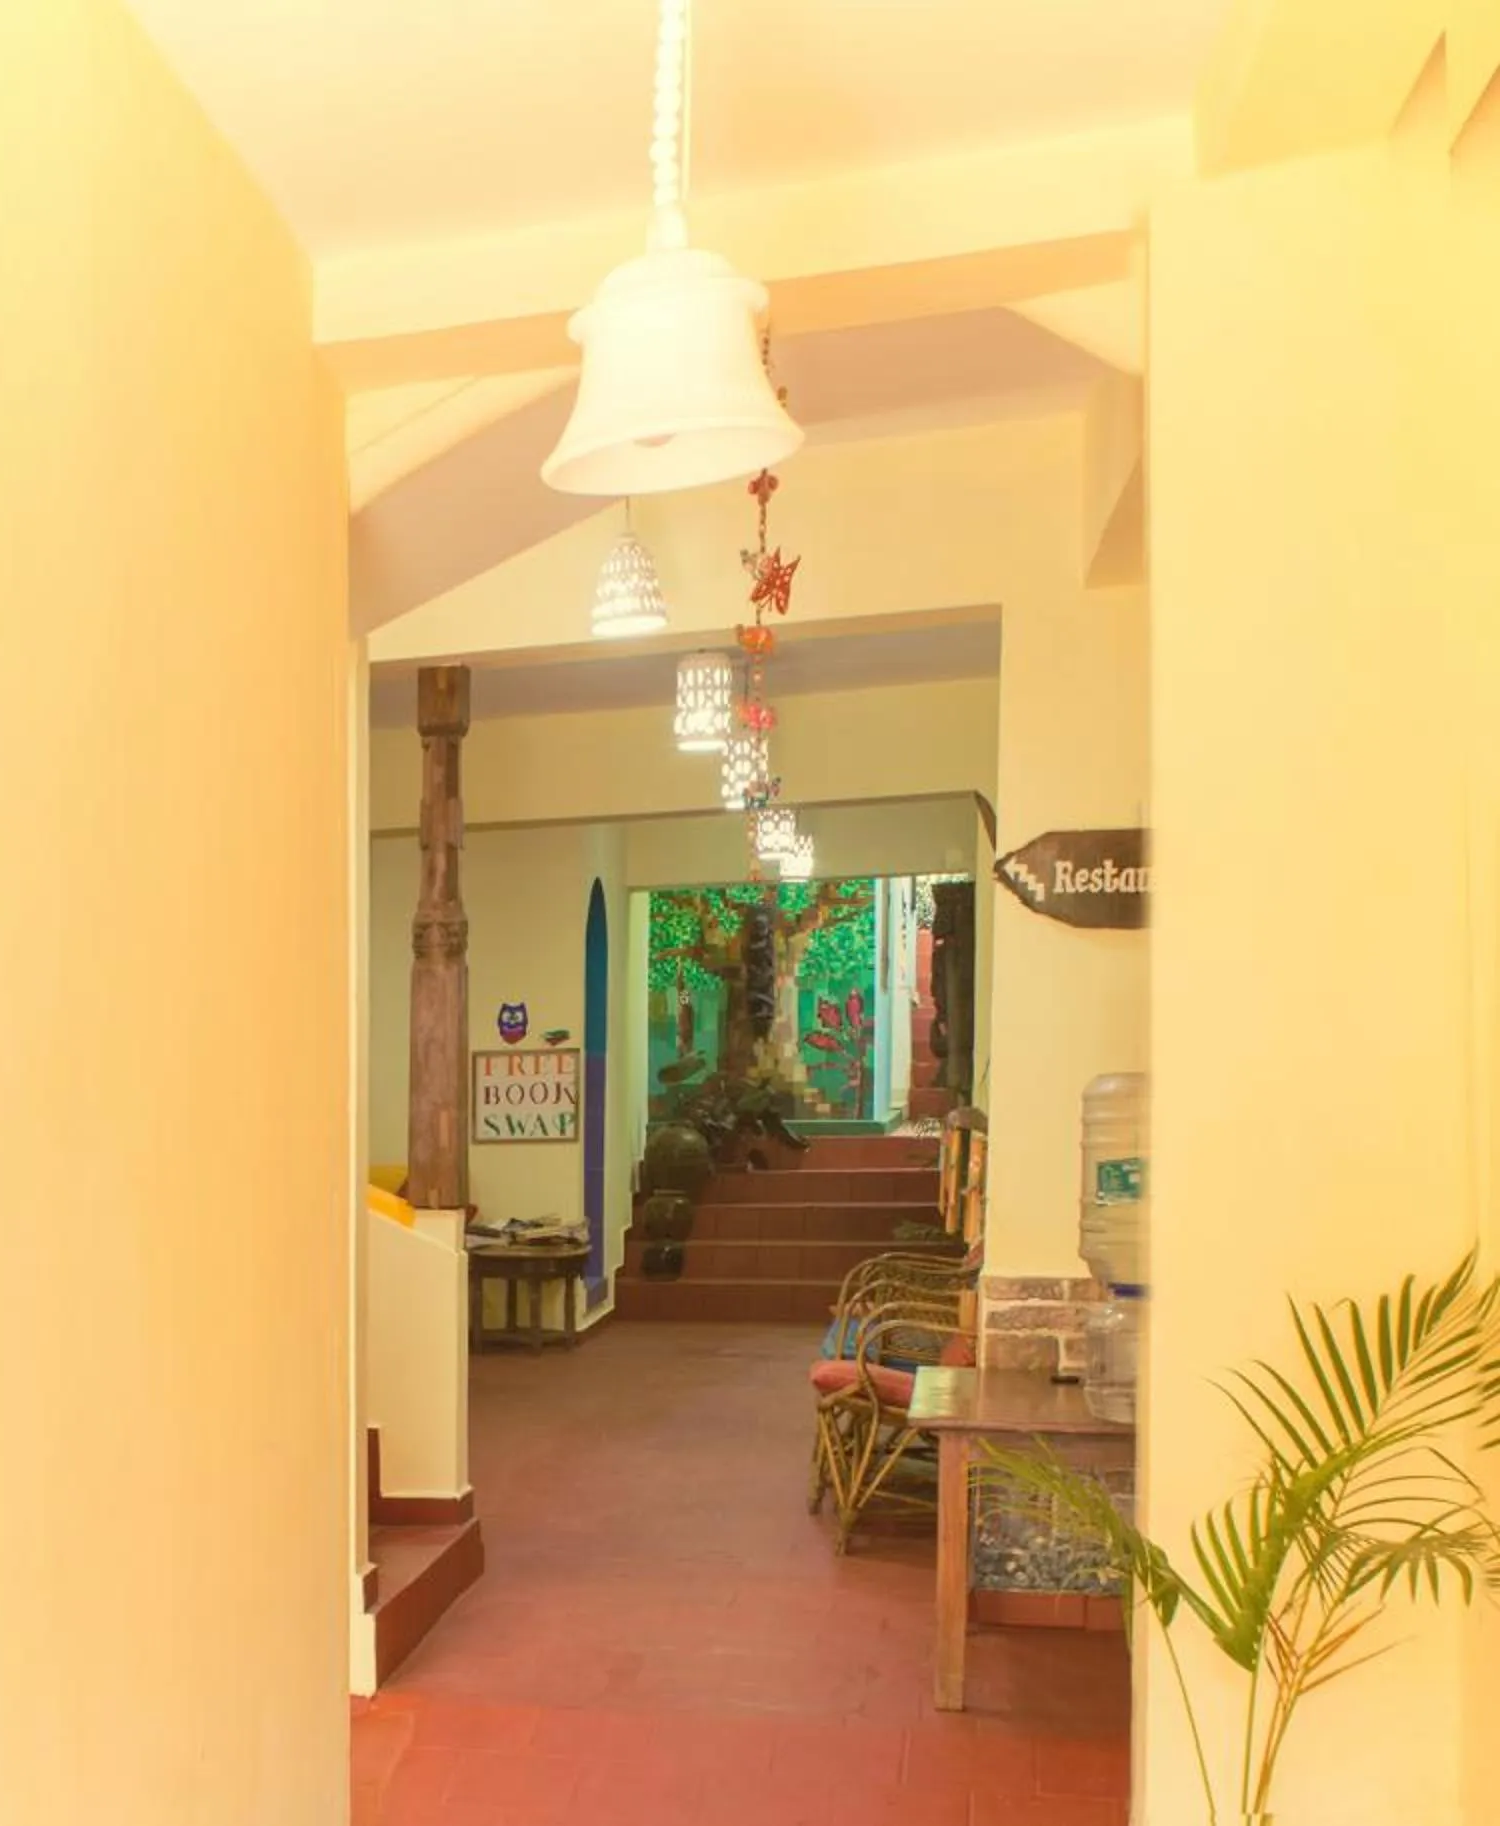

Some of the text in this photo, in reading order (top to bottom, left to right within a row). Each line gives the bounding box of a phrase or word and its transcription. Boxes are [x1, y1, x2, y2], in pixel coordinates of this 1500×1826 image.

[483, 1053, 574, 1076] FREE
[483, 1082, 578, 1106] BOOK
[483, 1113, 576, 1137] SWAP
